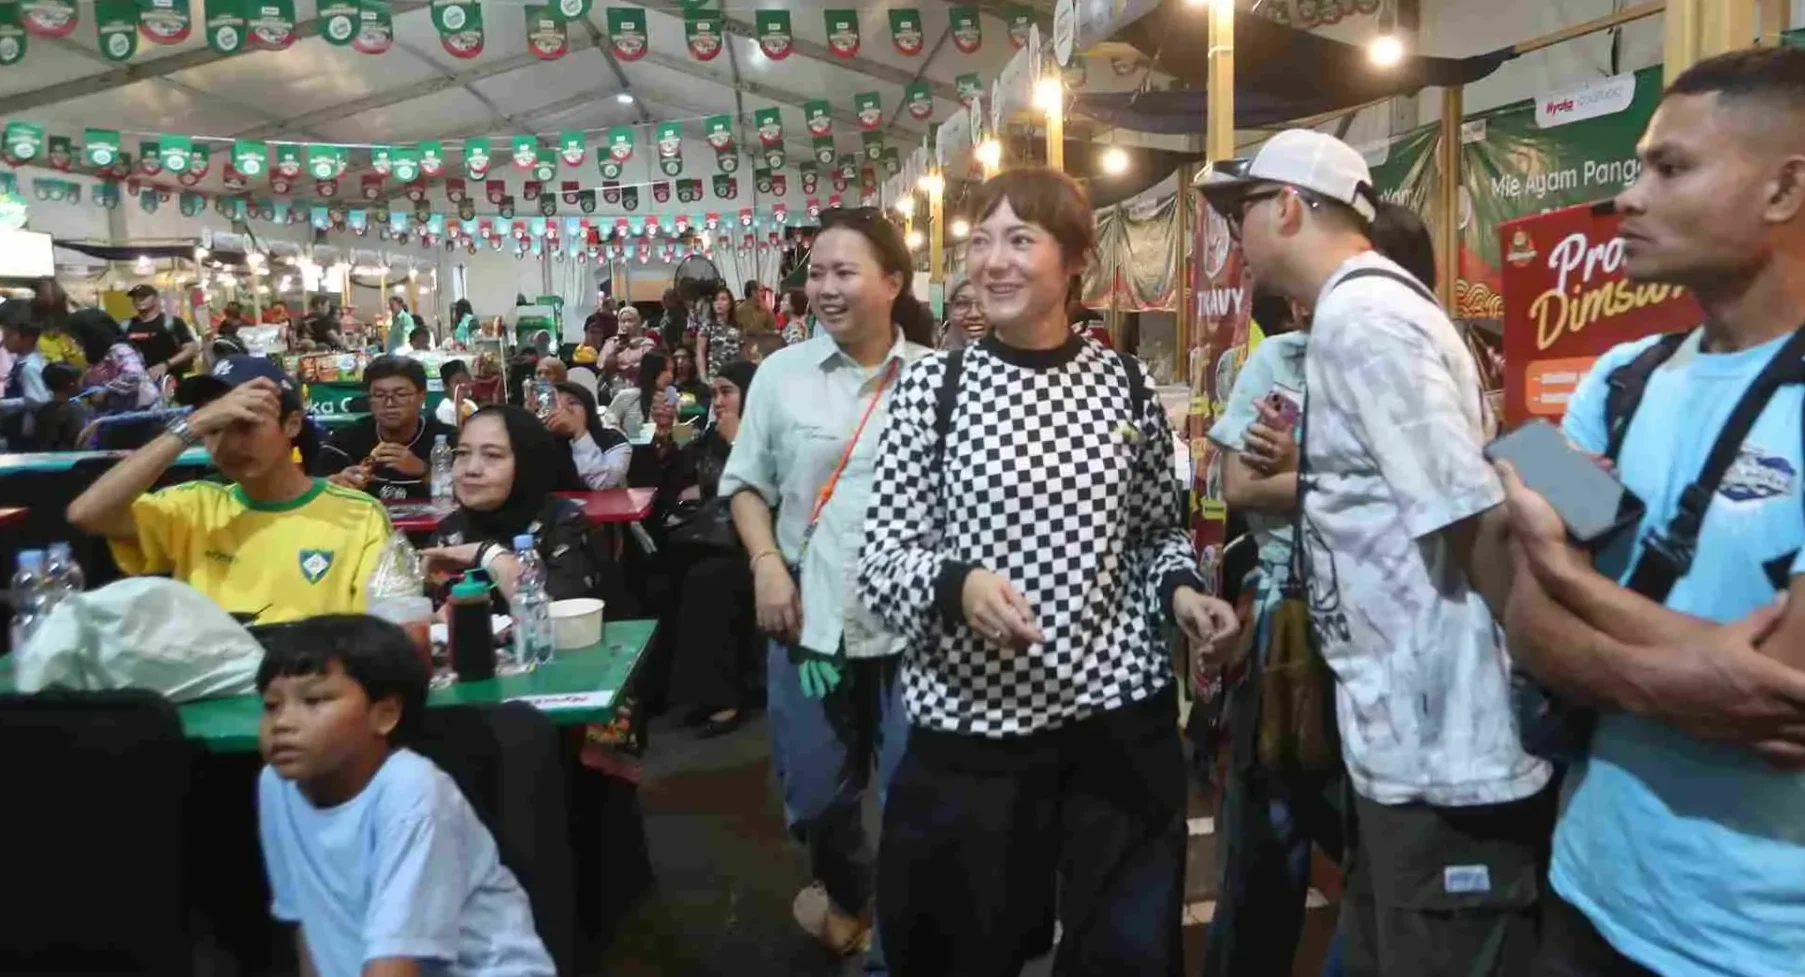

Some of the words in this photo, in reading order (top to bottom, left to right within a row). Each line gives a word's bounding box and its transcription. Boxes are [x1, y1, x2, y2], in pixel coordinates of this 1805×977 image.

[1491, 173, 1521, 198] Mie
[1525, 168, 1577, 198] Ayam
[1583, 157, 1642, 187] Pang
[1548, 233, 1628, 292] Pro
